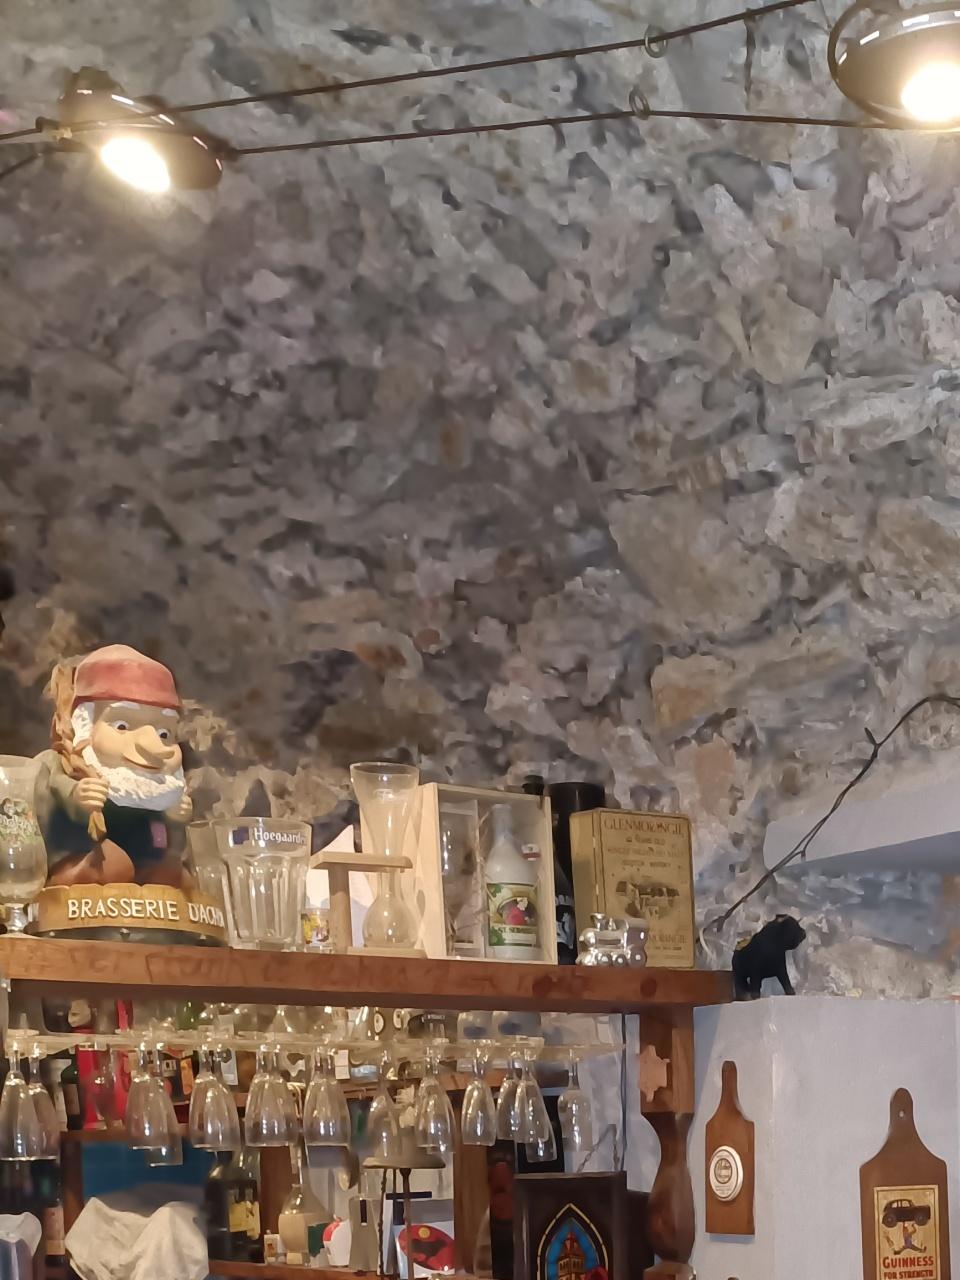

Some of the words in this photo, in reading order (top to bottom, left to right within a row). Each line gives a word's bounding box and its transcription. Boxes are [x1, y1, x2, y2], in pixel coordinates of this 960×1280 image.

[67, 898, 180, 921] BRASSERIE
[882, 1256, 934, 1269] GUINNESS
[883, 1271, 898, 1280] FOR
[899, 1269, 934, 1280] STRENGTH
